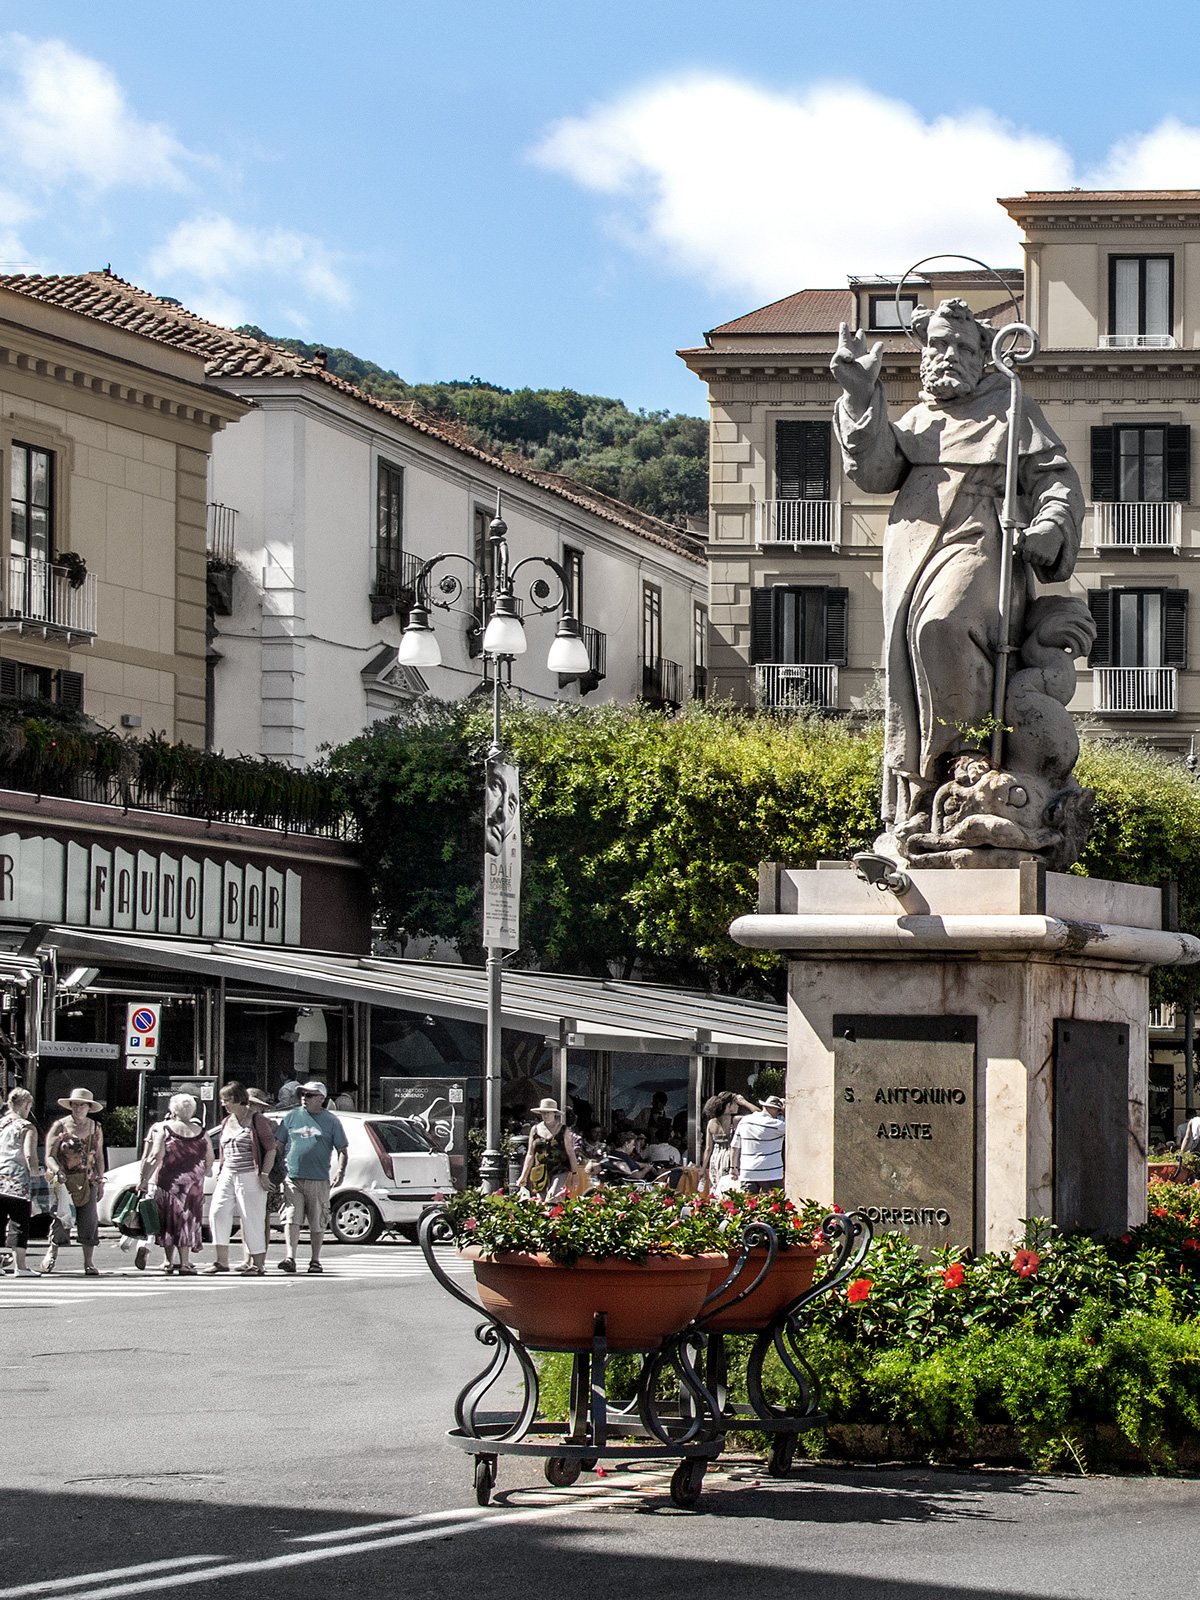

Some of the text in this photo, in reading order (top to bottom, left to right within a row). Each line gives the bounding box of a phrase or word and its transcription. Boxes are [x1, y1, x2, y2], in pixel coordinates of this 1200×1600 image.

[94, 865, 280, 929] FAUNO BAR
[844, 1086, 966, 1105] S. ANTONINO
[876, 1122, 933, 1140] ABATE
[857, 1205, 950, 1226] SORRENTO
